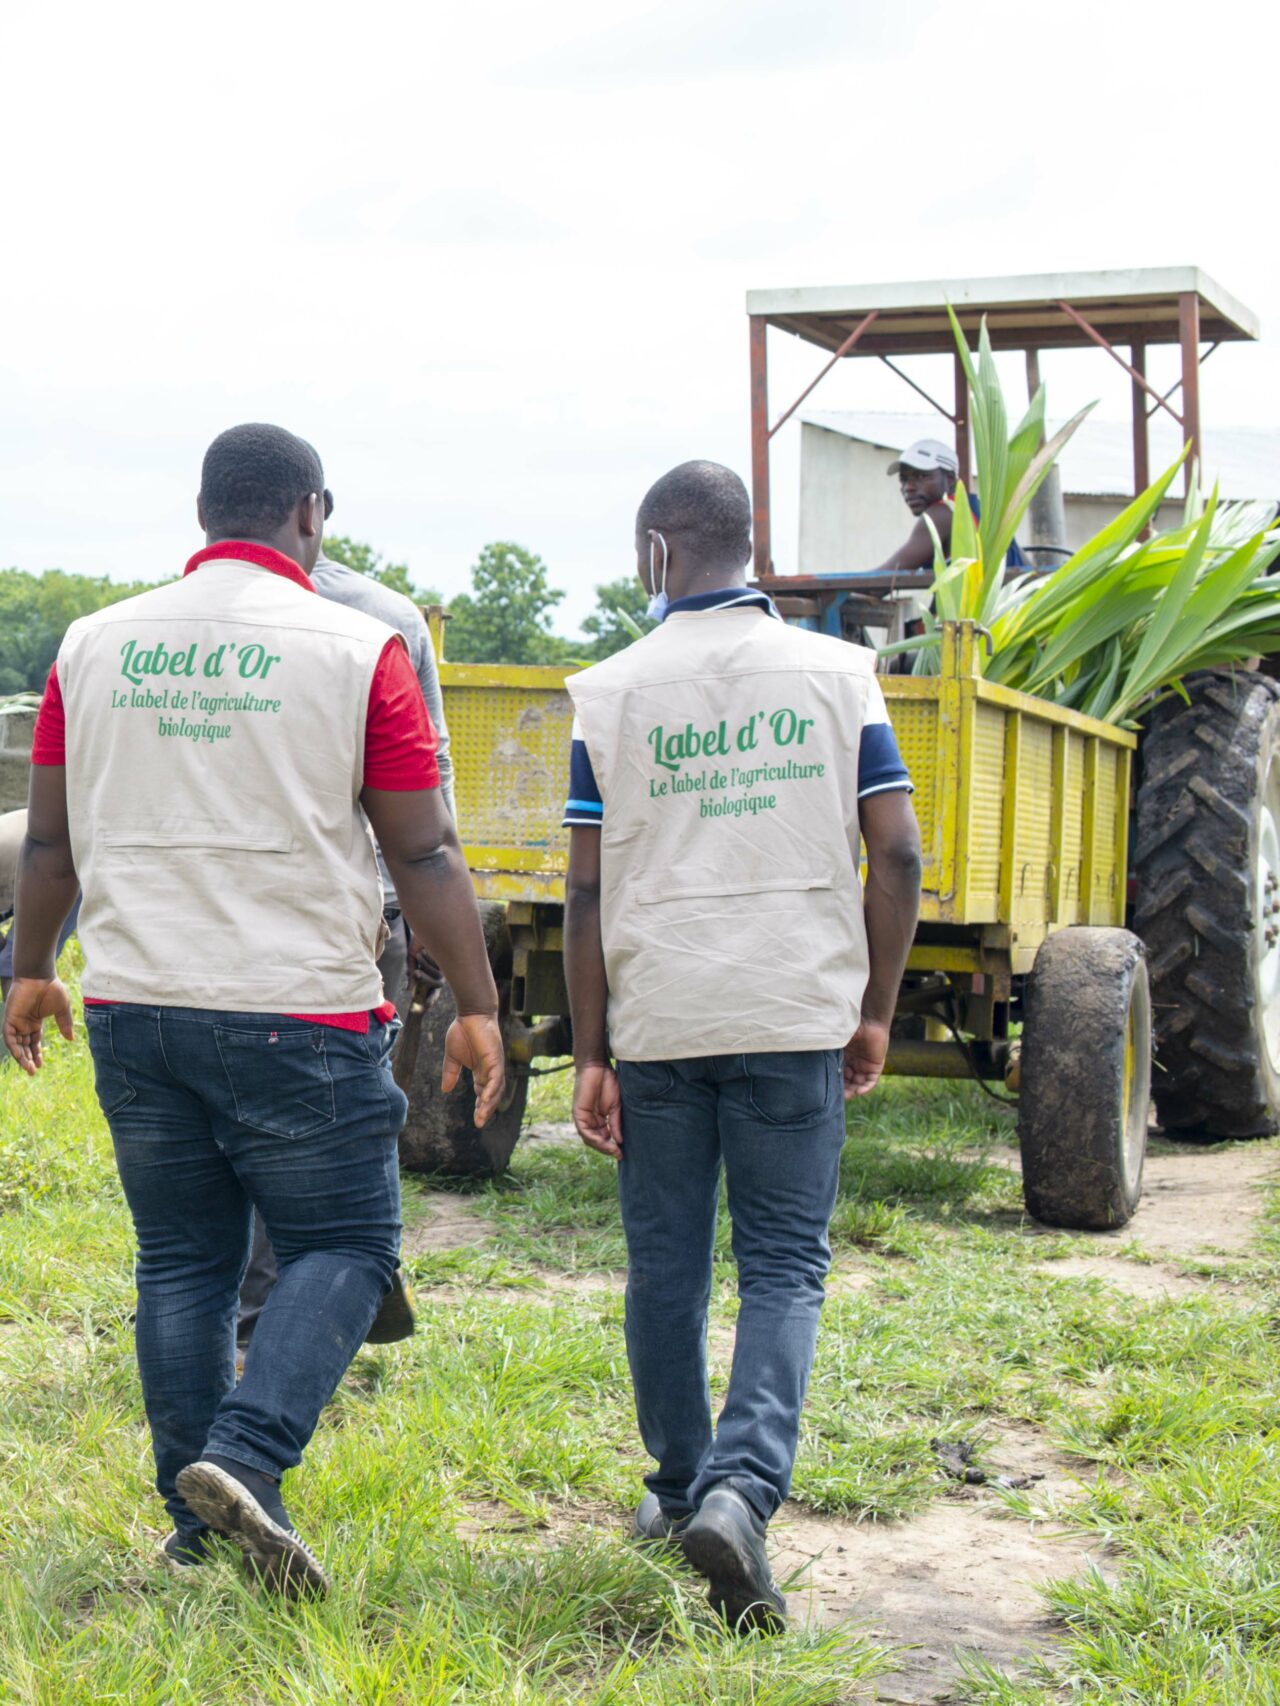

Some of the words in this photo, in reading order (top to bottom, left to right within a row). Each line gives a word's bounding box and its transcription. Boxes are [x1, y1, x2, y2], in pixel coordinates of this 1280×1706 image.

[120, 640, 196, 686] Label
[111, 690, 127, 709] Le
[131, 688, 168, 710] label
[171, 690, 189, 710] de
[191, 691, 282, 716] l'agriculture
[158, 716, 232, 743] biologique
[647, 720, 731, 772] Label
[649, 779, 668, 798] Le
[671, 770, 706, 795] label
[709, 770, 728, 790] de
[730, 760, 825, 787] l'agriculture
[700, 793, 777, 818] biologique
